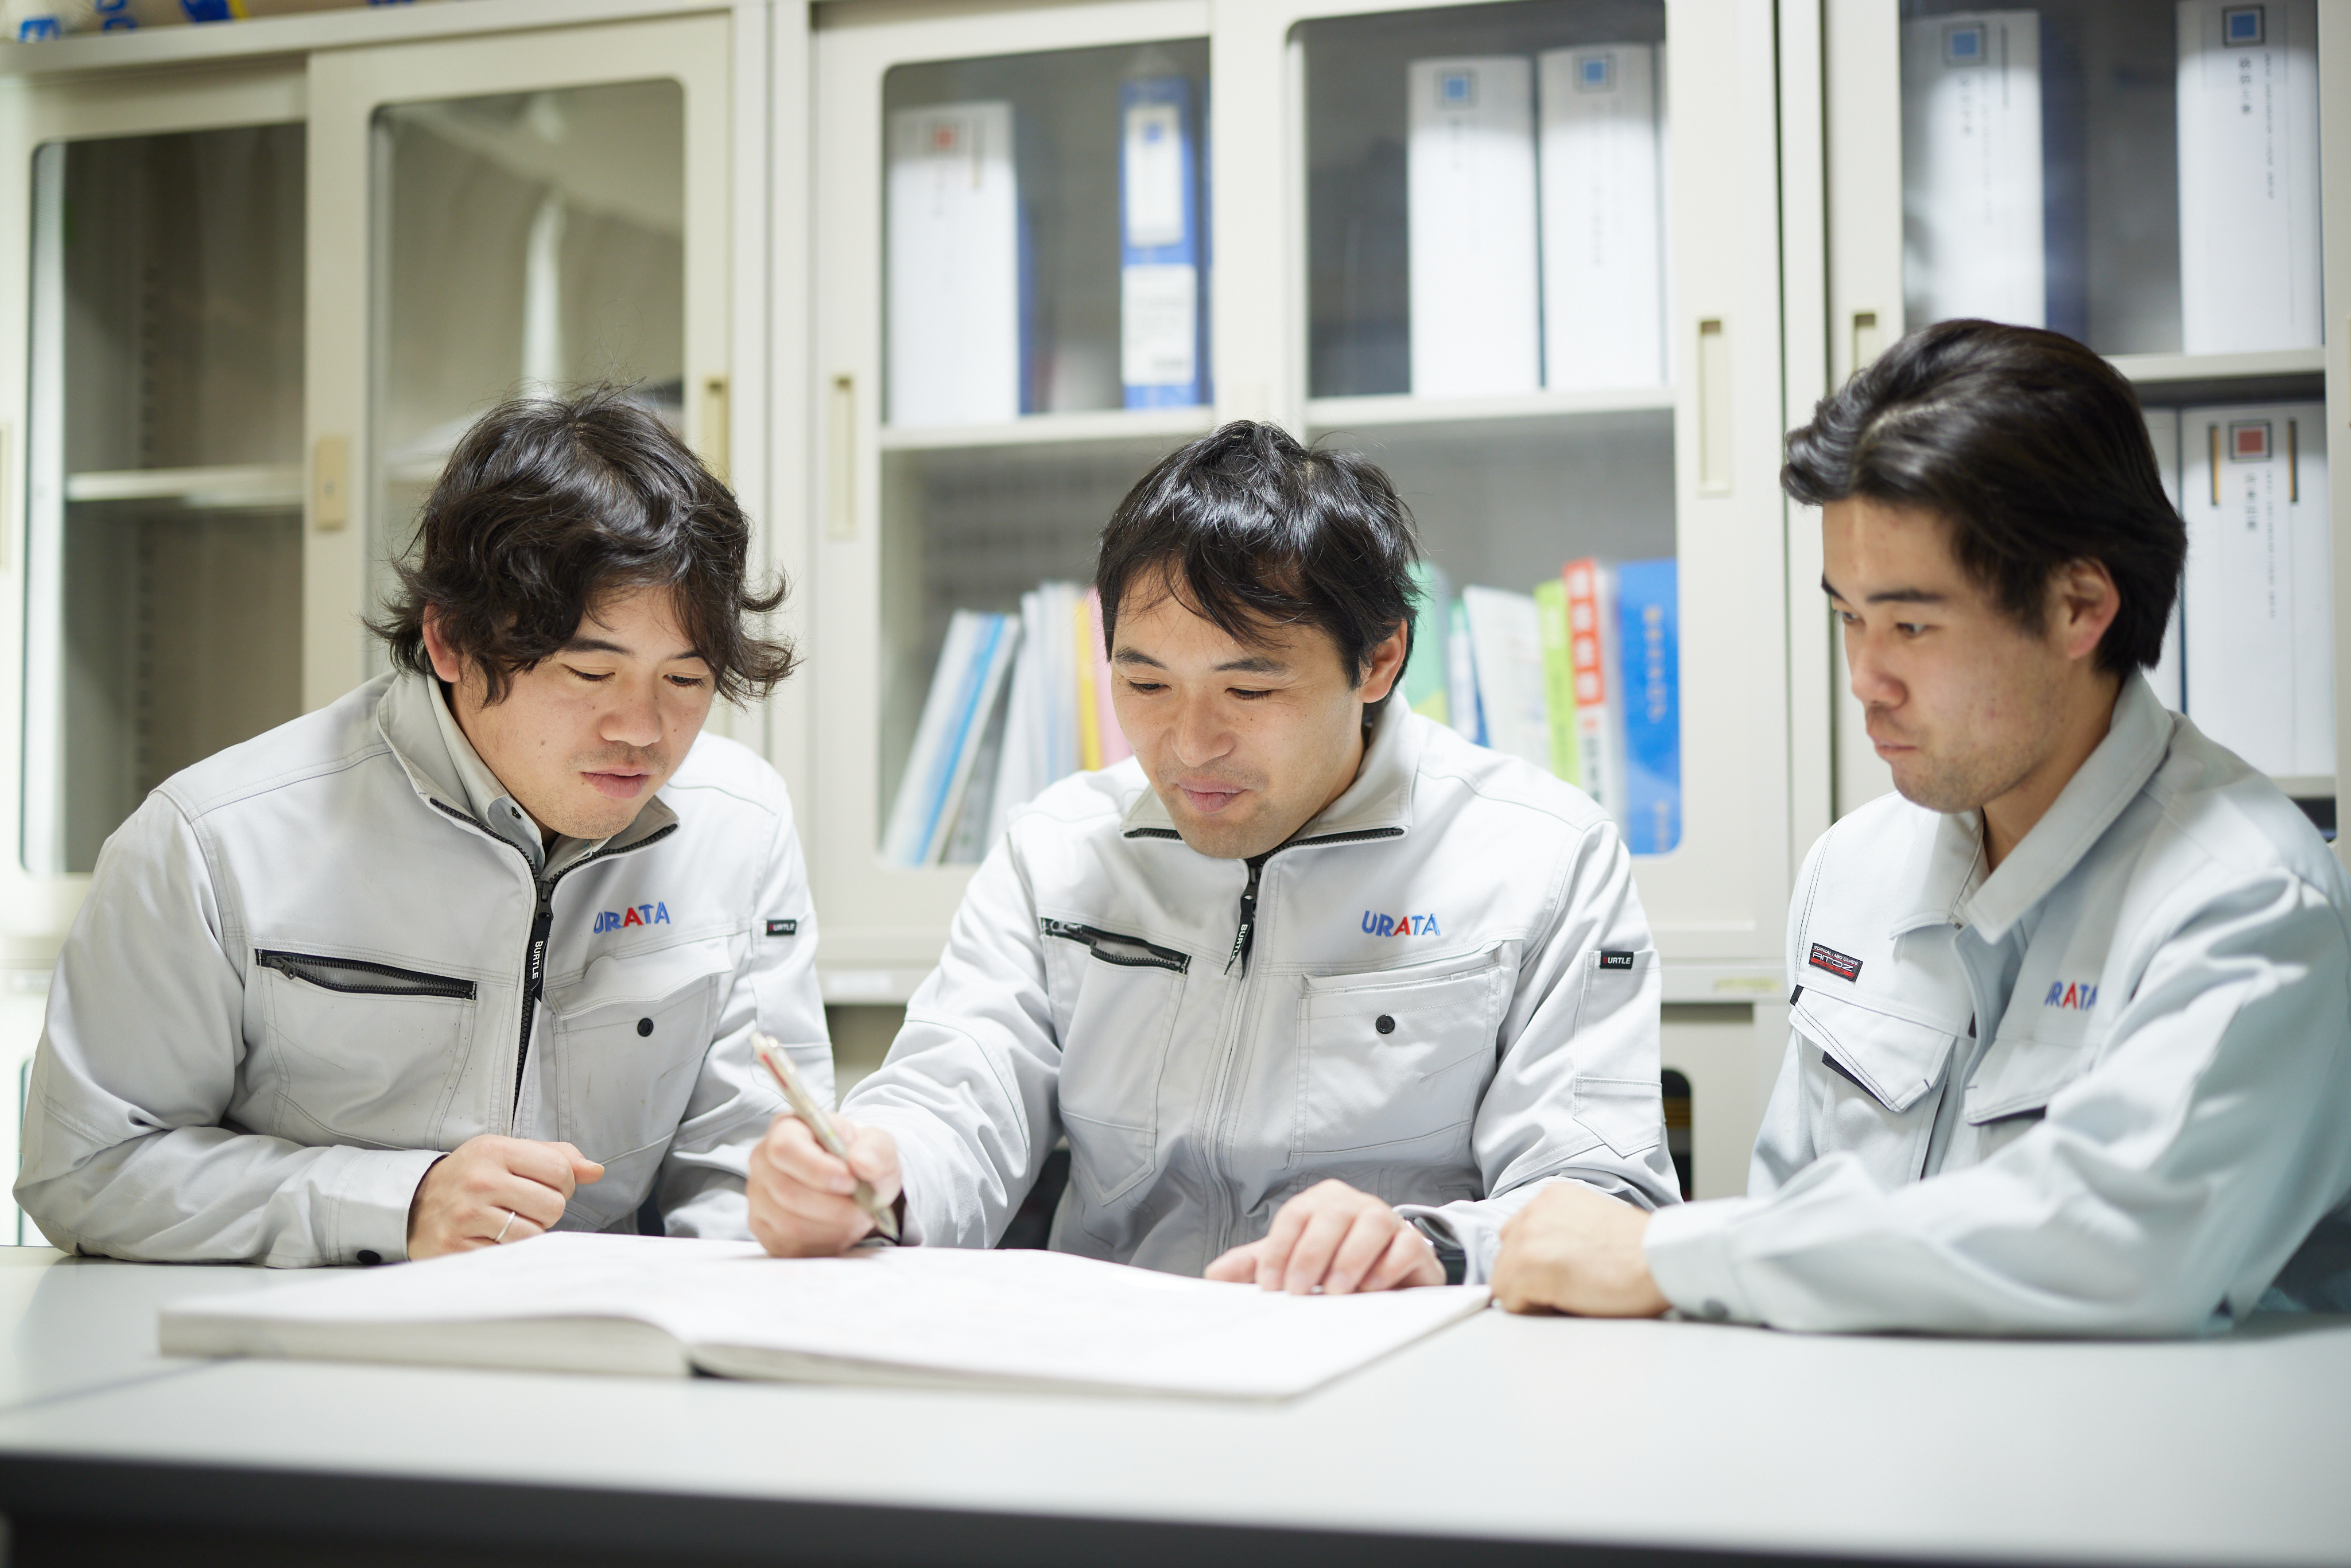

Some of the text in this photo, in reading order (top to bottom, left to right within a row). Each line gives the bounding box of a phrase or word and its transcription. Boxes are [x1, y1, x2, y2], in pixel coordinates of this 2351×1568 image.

[593, 901, 670, 934] URATA
[1361, 910, 1441, 937] URATA
[1230, 924, 1248, 962] BURTLE
[1813, 945, 1832, 957] TECHNICAL
[532, 941, 544, 980] BURTLE
[1813, 951, 1854, 972] AITOZ
